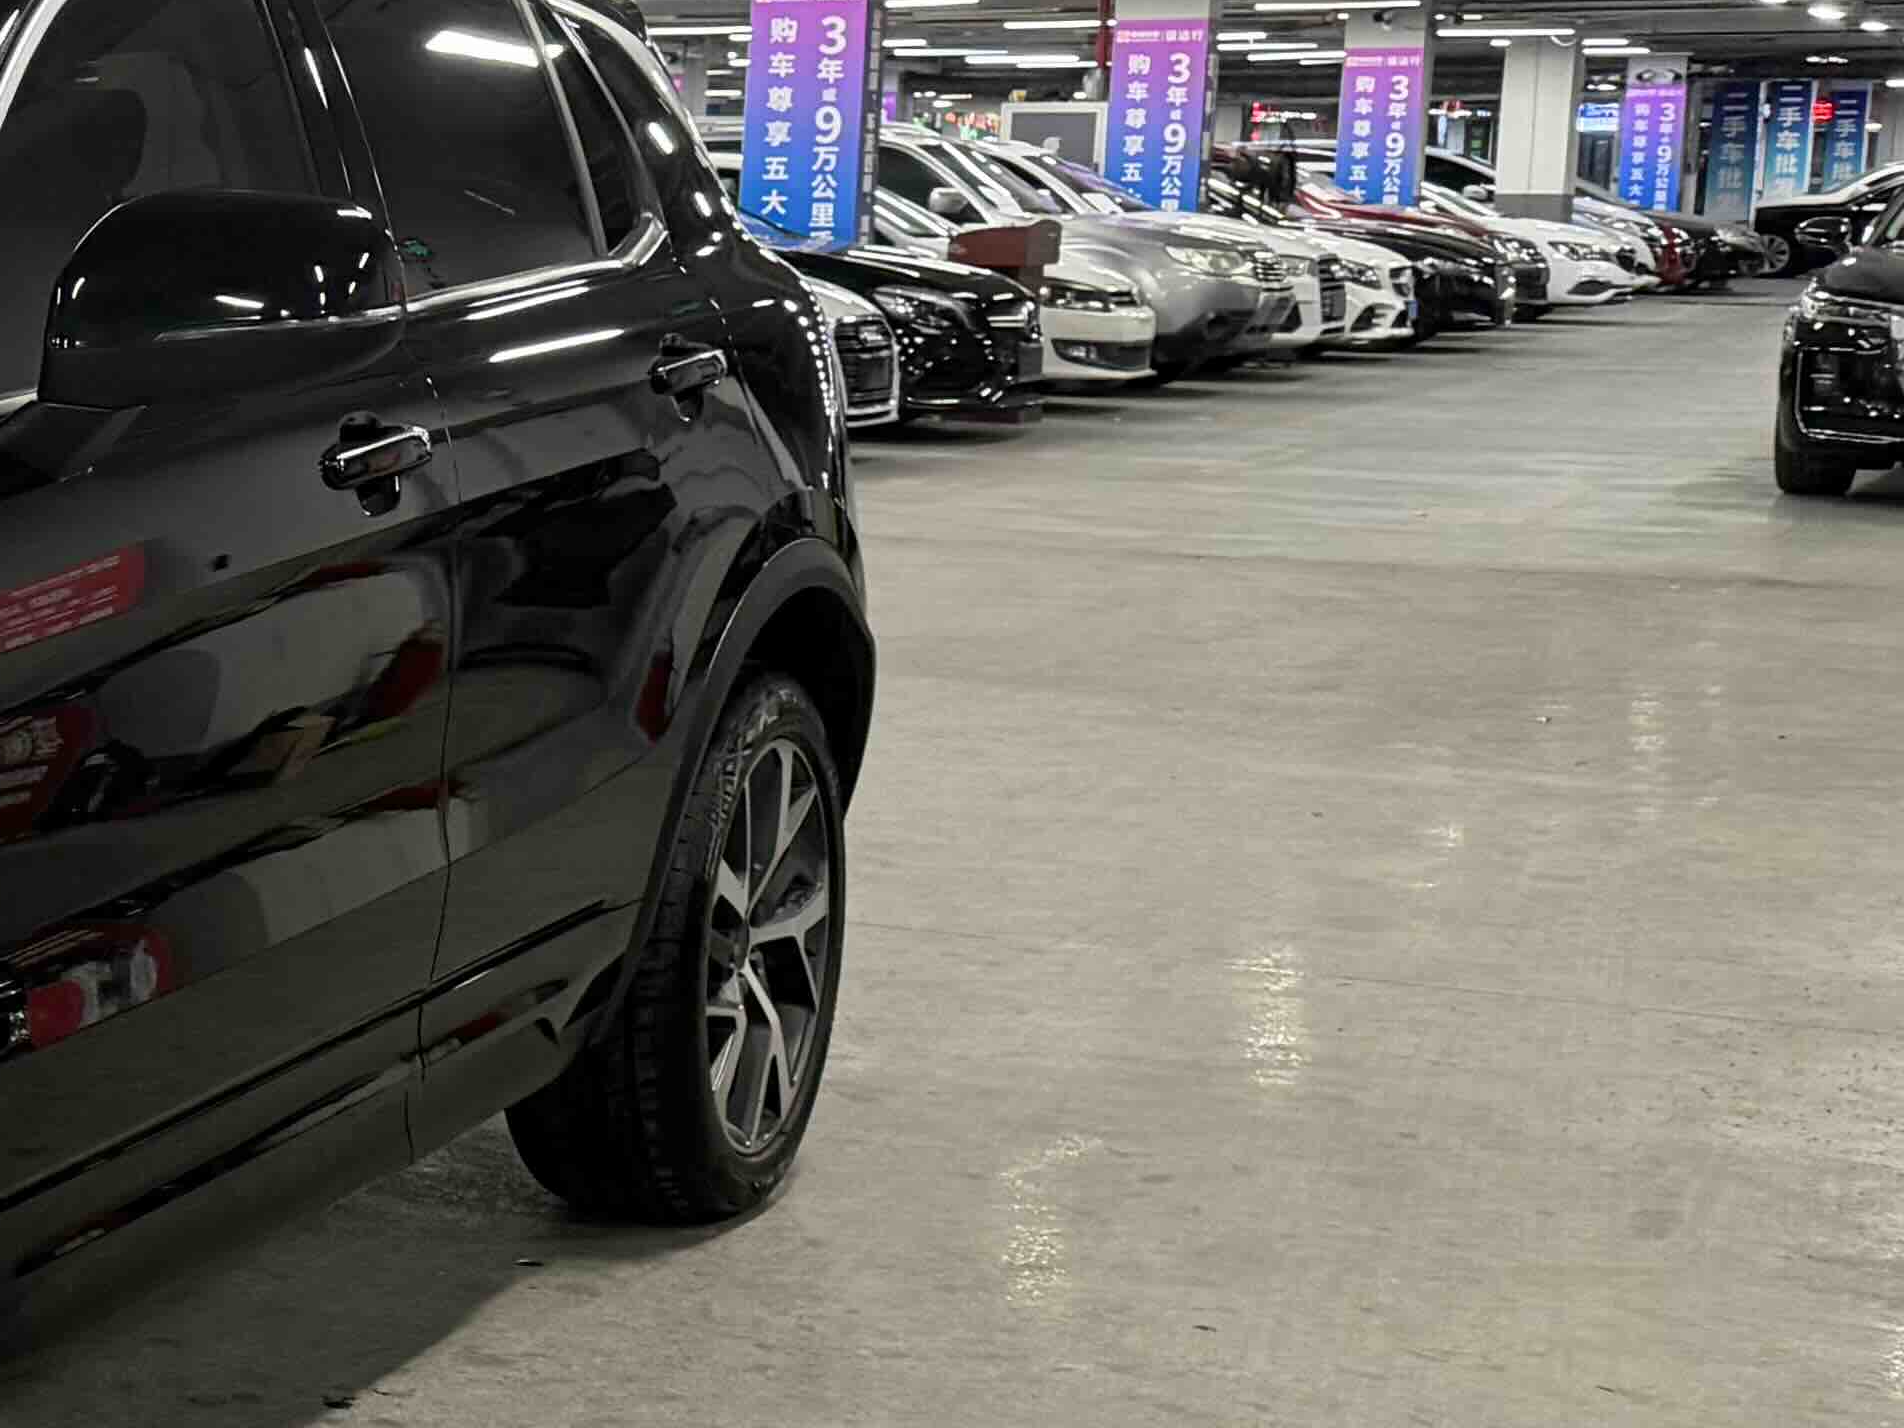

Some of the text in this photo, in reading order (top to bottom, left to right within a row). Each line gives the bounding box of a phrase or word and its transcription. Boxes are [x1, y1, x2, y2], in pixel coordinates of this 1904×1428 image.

[761, 17, 799, 227] 购车尊享五大
[1120, 53, 1151, 199] 购车尊享五
